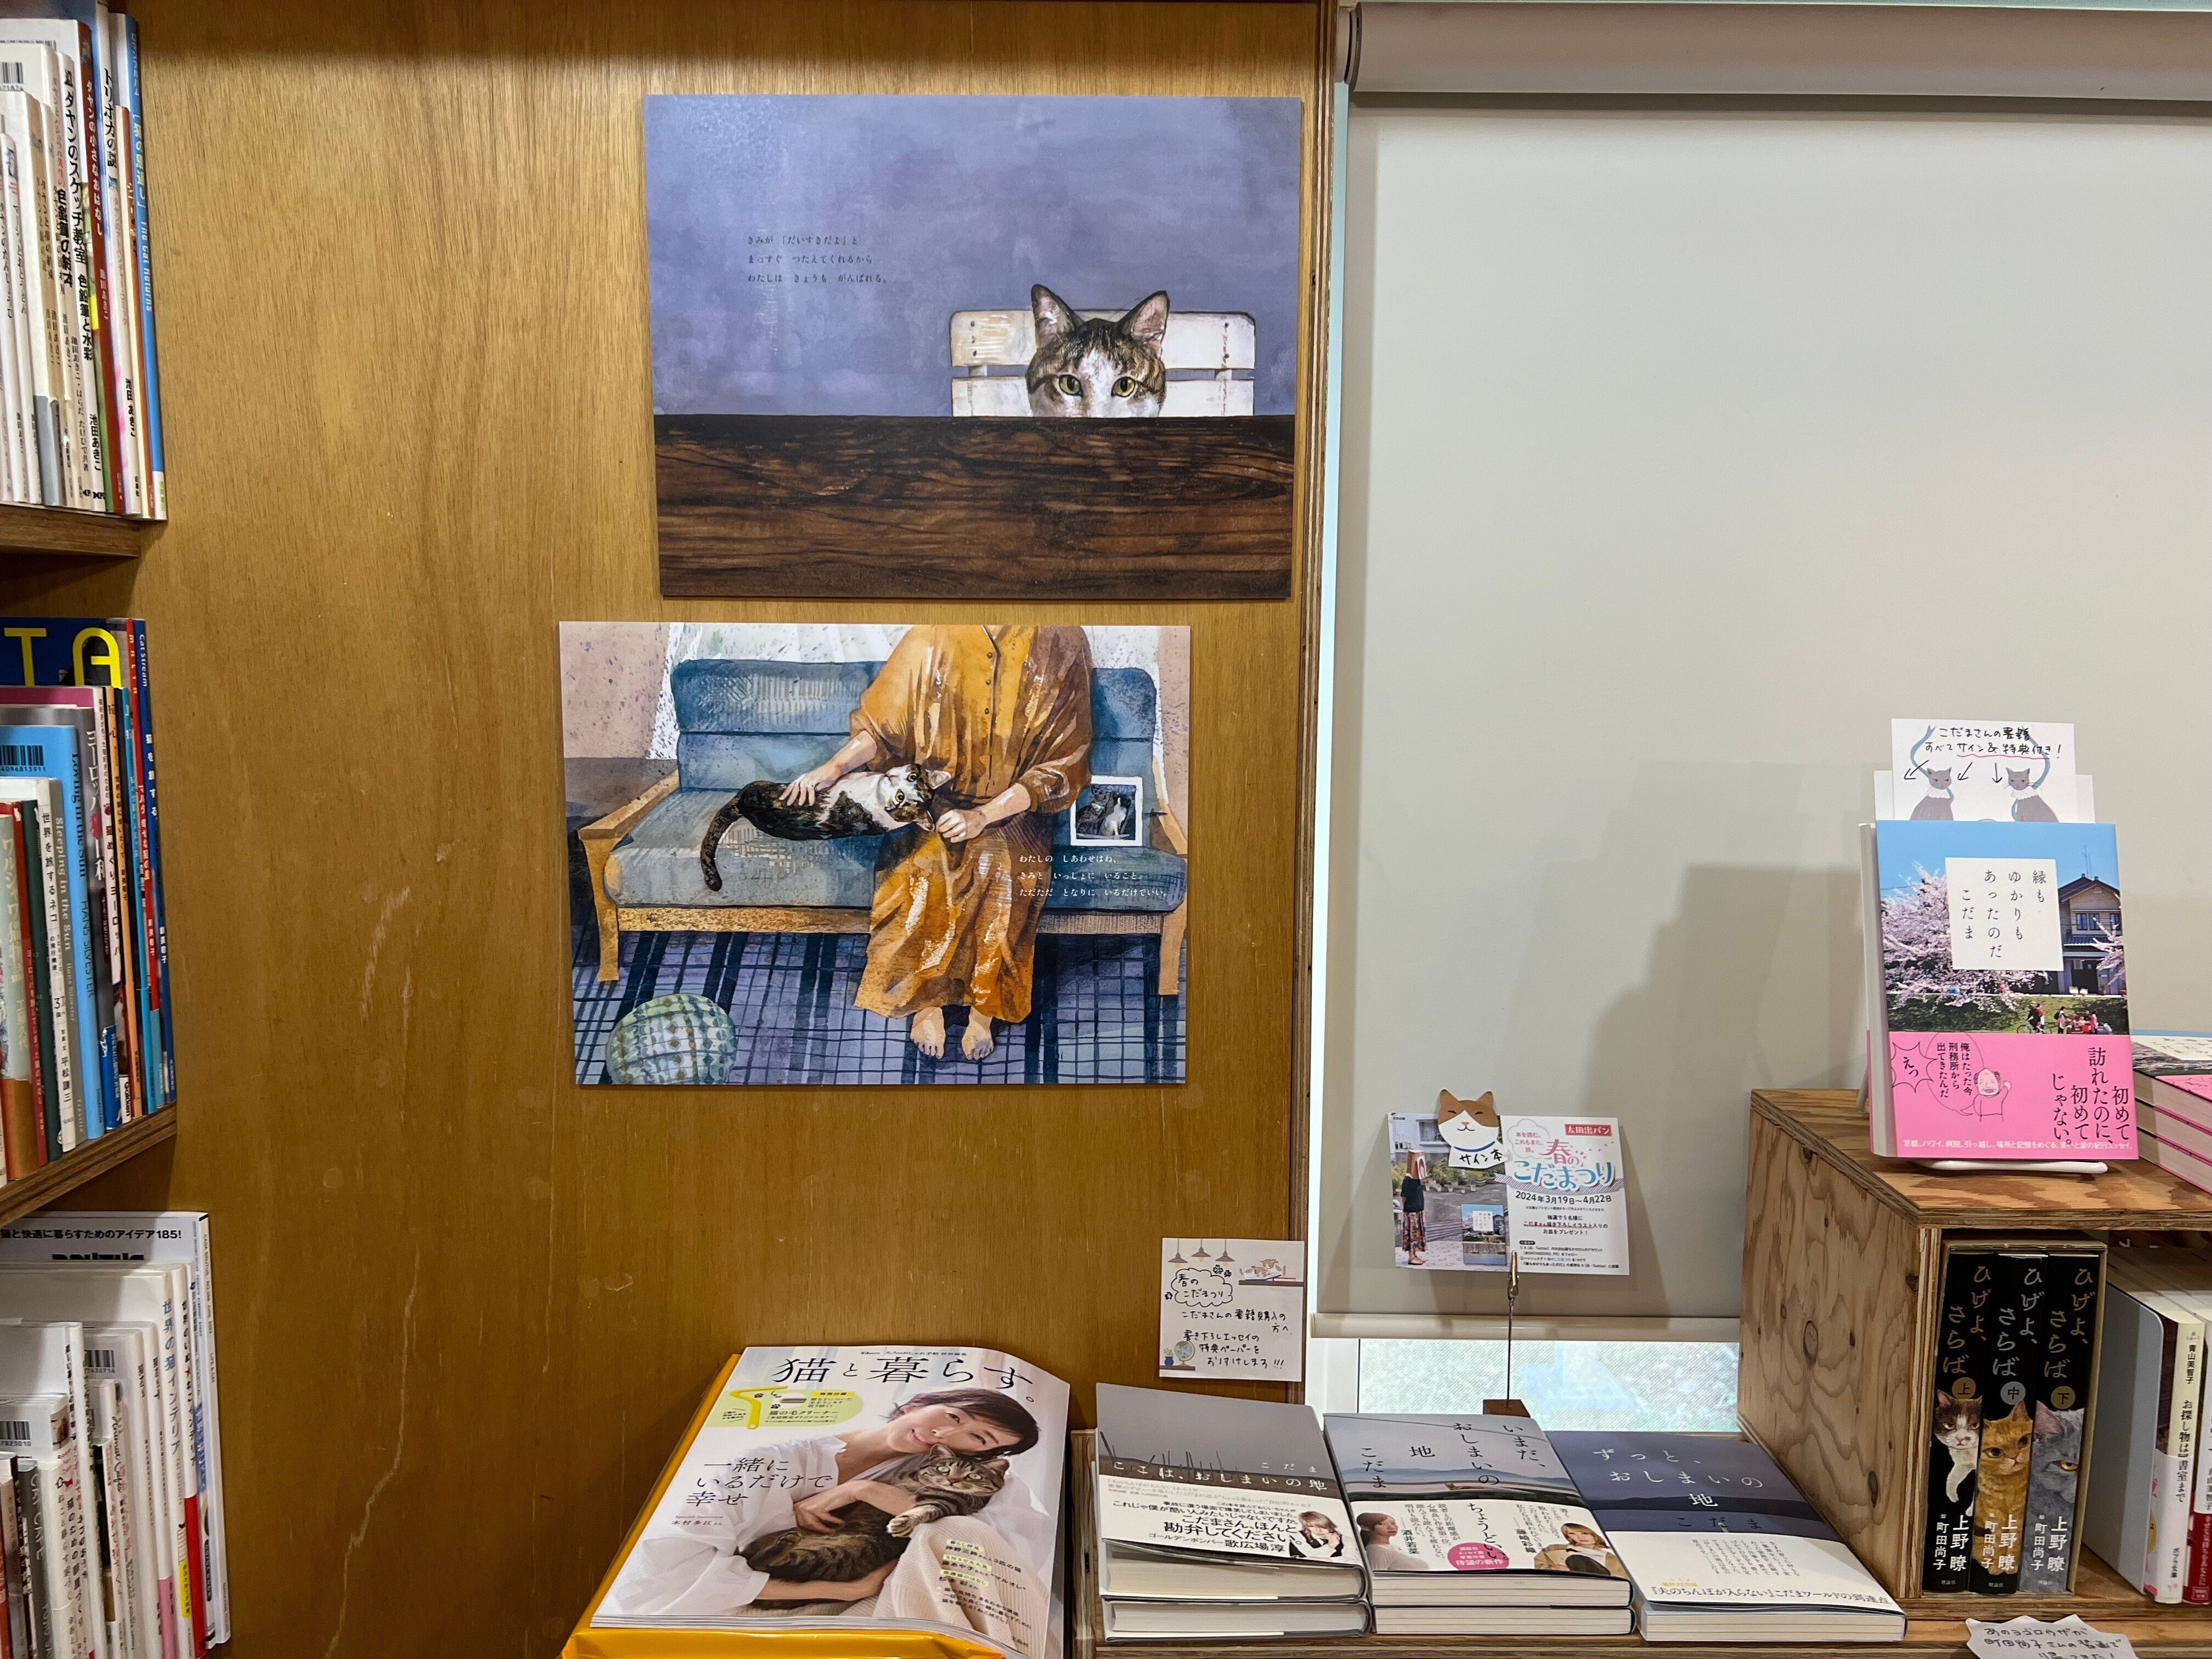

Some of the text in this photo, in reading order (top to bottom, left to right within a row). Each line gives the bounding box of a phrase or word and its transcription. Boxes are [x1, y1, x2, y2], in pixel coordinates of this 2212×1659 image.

[748, 236, 773, 245] きみが
[748, 255, 872, 264] まっすぐ つたえてくれるから
[748, 274, 887, 283] わたしは きょうも がんばれる。
[1939, 726, 2030, 741] こだまさんの書籍
[1019, 854, 1118, 863] わたしの しあわせはね、
[55, 817, 71, 951] Sleeping in the Sun
[1019, 872, 1143, 880] きみと いっしょに いること。
[2032, 870, 2047, 902] 縁も
[1019, 888, 1167, 897] ただただ となりに いるだけでいい。
[2008, 871, 2023, 940] ゆかりも
[1961, 889, 1974, 939] こだま
[1984, 870, 2002, 958] あったのだ
[1903, 1057, 1919, 1077] えっ
[1937, 1042, 1949, 1098] 出てきたんだ
[1949, 1042, 1960, 1090] 刑務所から
[1960, 1042, 1973, 1096] 俺はたった今
[2088, 1047, 2113, 1144] 訪れたのに、
[2051, 1074, 2072, 1145] じゃない。
[2070, 1085, 2089, 1139] 初めて
[2112, 1085, 2130, 1141] 初めて
[1538, 1138, 1580, 1165] 春の
[1514, 1160, 1612, 1189] こだまつり
[1178, 1274, 1198, 1287] 春の
[1184, 1288, 1224, 1299] こだまつり
[1181, 1308, 1286, 1322] こだまさんの書籍購入の
[1970, 1265, 1991, 1342] ひげよ、
[2019, 1268, 2045, 1344] ひげよ、
[2070, 1268, 2096, 1344] ひげよ、
[1183, 1329, 1260, 1341] 書き下ろしエッセイの
[1943, 1305, 1970, 1374] さらば
[1993, 1307, 2020, 1377] さらば
[2044, 1310, 2071, 1379] さらば
[1199, 1343, 1260, 1354] 特典ペーパーを
[774, 1357, 1035, 1403] 猫と暮らす。
[1957, 1383, 1971, 1395] 上
[2007, 1386, 2021, 1400] 中
[2057, 1392, 2070, 1406] 下
[1408, 1446, 1436, 1458] 地
[1453, 1422, 1500, 1486] おしまいの
[1502, 1424, 1546, 1468] いまだ、
[1593, 1448, 1701, 1464] ずっと、
[704, 1457, 789, 1472] 一緒に
[1113, 1460, 1328, 1491] ここは、おしまいの地
[1261, 1462, 1318, 1473] こだま
[1361, 1447, 1387, 1489] こだま
[697, 1474, 833, 1489] いるだけで
[1610, 1470, 1764, 1488] おしまいの
[686, 1491, 748, 1507] 幸せ
[1689, 1493, 1719, 1508] 地
[1163, 1521, 1303, 1545] 勘弁してください。
[1182, 1515, 1299, 1533] こだまさん、ほんと
[1466, 1503, 1510, 1560] ちょうどいい。
[1677, 1516, 1763, 1530] こだま
[1225, 1539, 1285, 1553] 歌広場淳
[1401, 1529, 1420, 1555] 酒井若菜
[1933, 1522, 1949, 1571] 町田尚子
[1981, 1521, 1998, 1570] 町田尚子
[2030, 1522, 2048, 1572] 町田尚子
